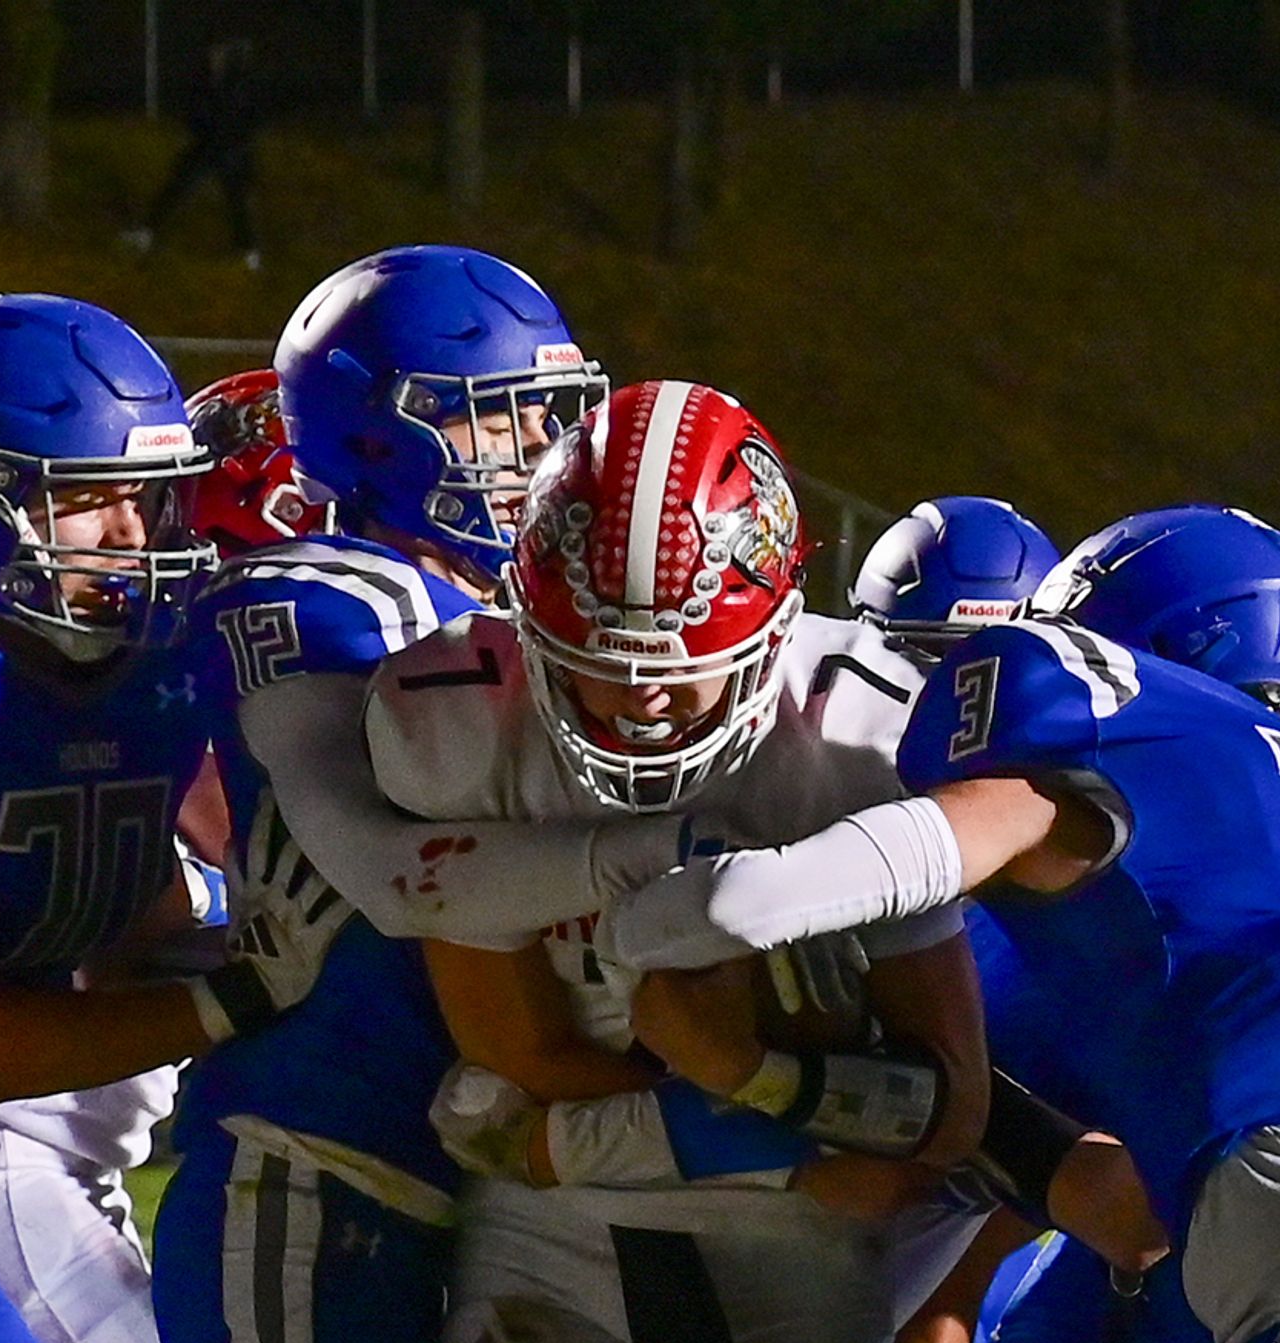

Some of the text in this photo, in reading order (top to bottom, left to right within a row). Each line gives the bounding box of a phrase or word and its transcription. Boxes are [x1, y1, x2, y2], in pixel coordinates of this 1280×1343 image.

[215, 600, 307, 697] 12
[598, 633, 671, 655] Riddell
[948, 656, 1001, 762] 3
